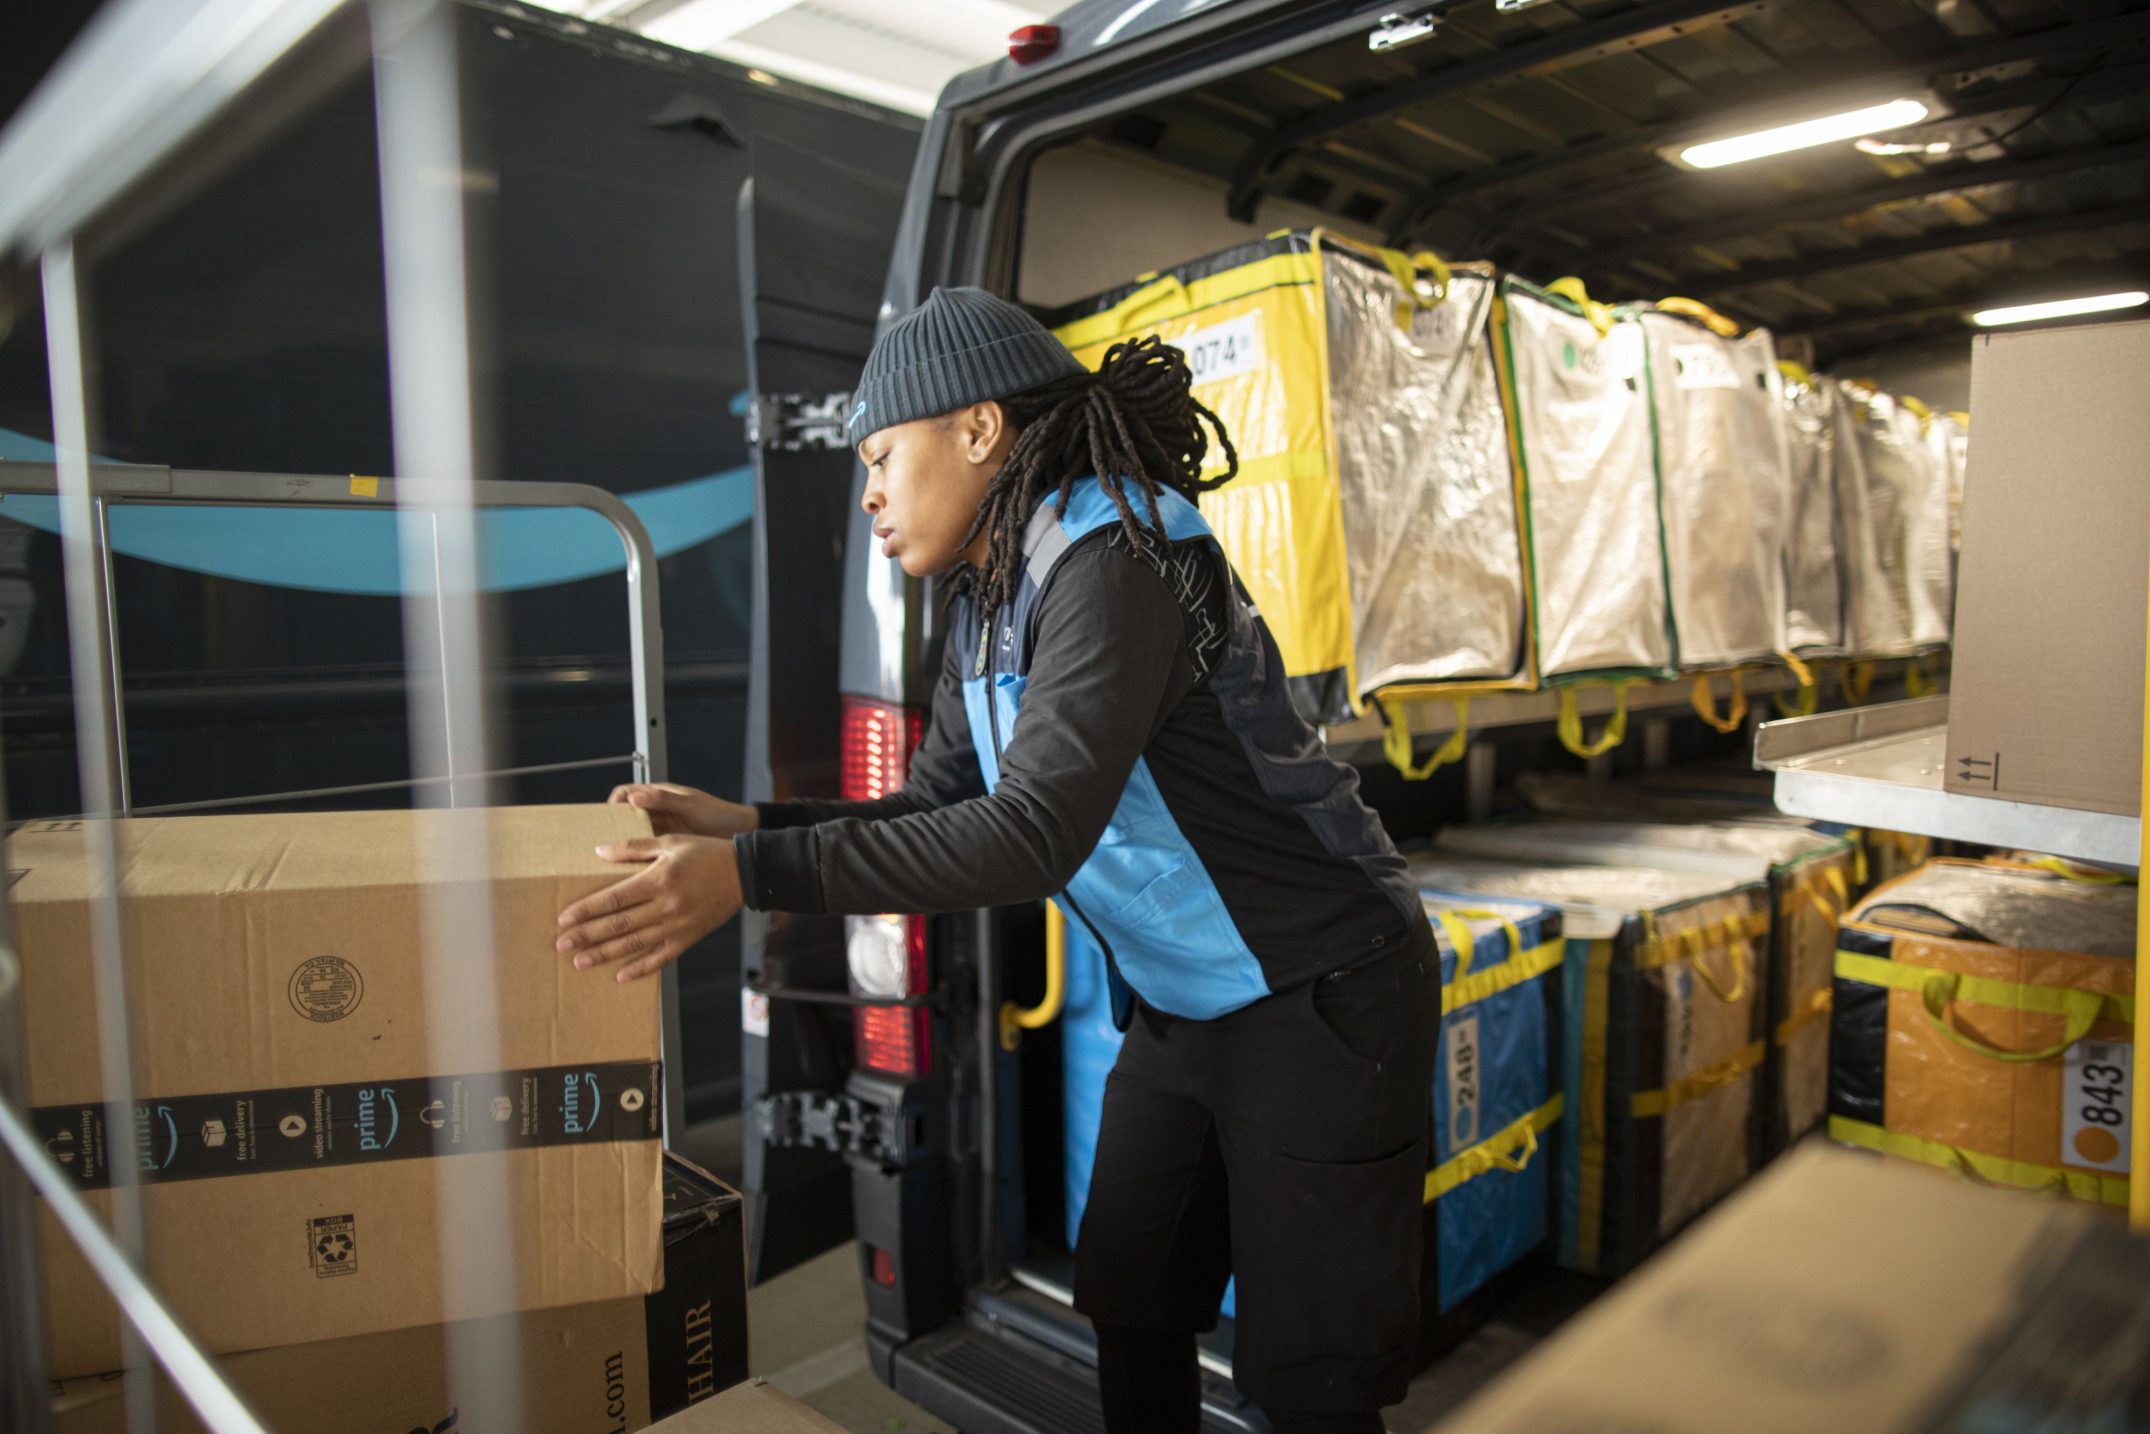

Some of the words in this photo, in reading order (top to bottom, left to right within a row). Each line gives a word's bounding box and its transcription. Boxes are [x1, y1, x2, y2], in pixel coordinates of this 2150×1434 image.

[1193, 334, 1236, 376] 074
[312, 1088, 324, 1132] streaming
[559, 1073, 583, 1134] prime
[2081, 1063, 2124, 1127] 843
[80, 1110, 93, 1155] listening
[234, 1100, 247, 1139] delivery
[353, 1089, 381, 1150] prime
[82, 1157, 94, 1177] free
[236, 1141, 247, 1160] free
[313, 1134, 325, 1159] video
[685, 1299, 714, 1402] HAIR
